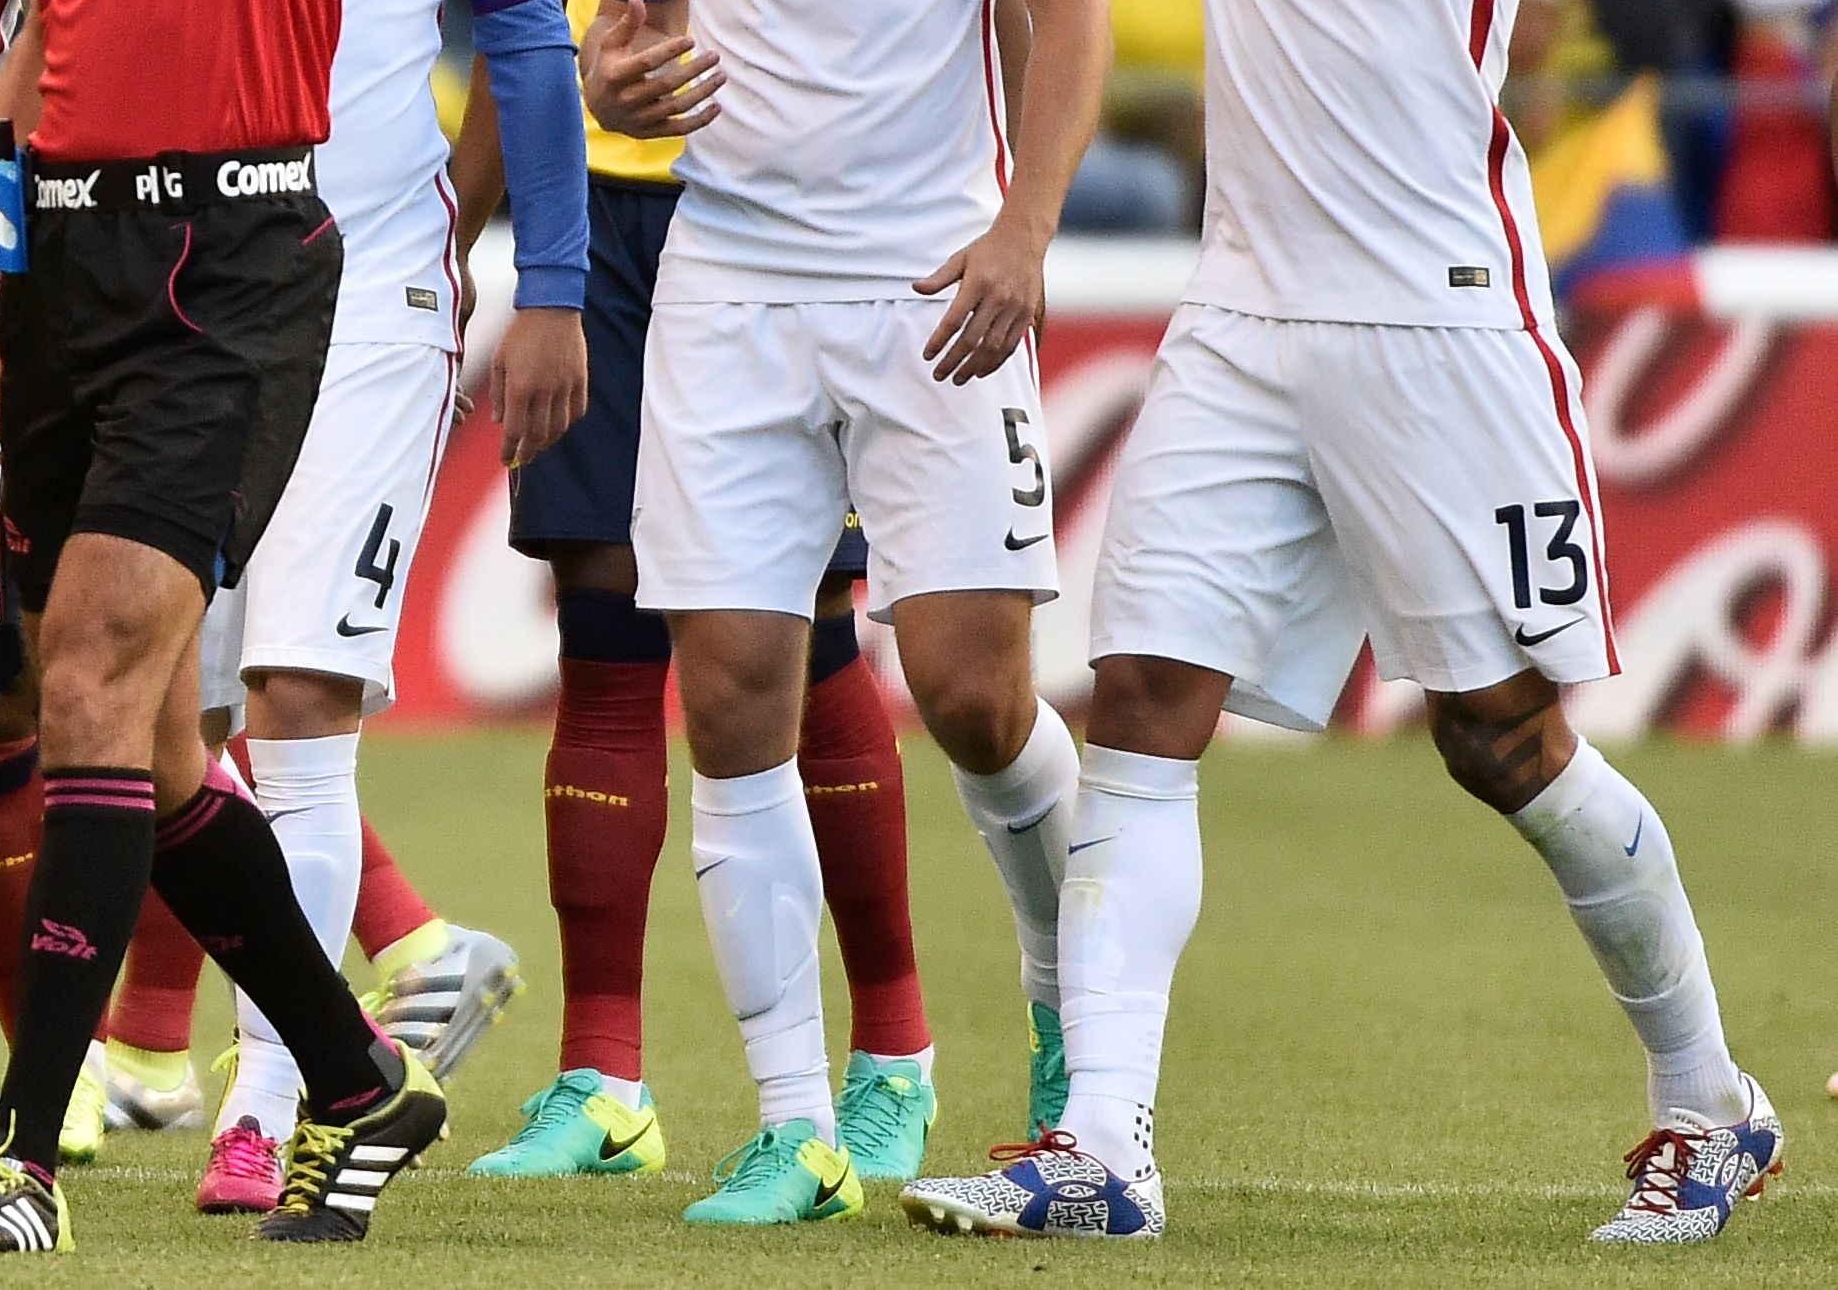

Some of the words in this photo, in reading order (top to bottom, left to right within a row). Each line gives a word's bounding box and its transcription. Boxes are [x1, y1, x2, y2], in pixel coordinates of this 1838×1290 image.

[216, 151, 312, 198] Comex
[1000, 407, 1045, 507] 5
[354, 502, 401, 610] 4
[1494, 499, 1589, 610] 13
